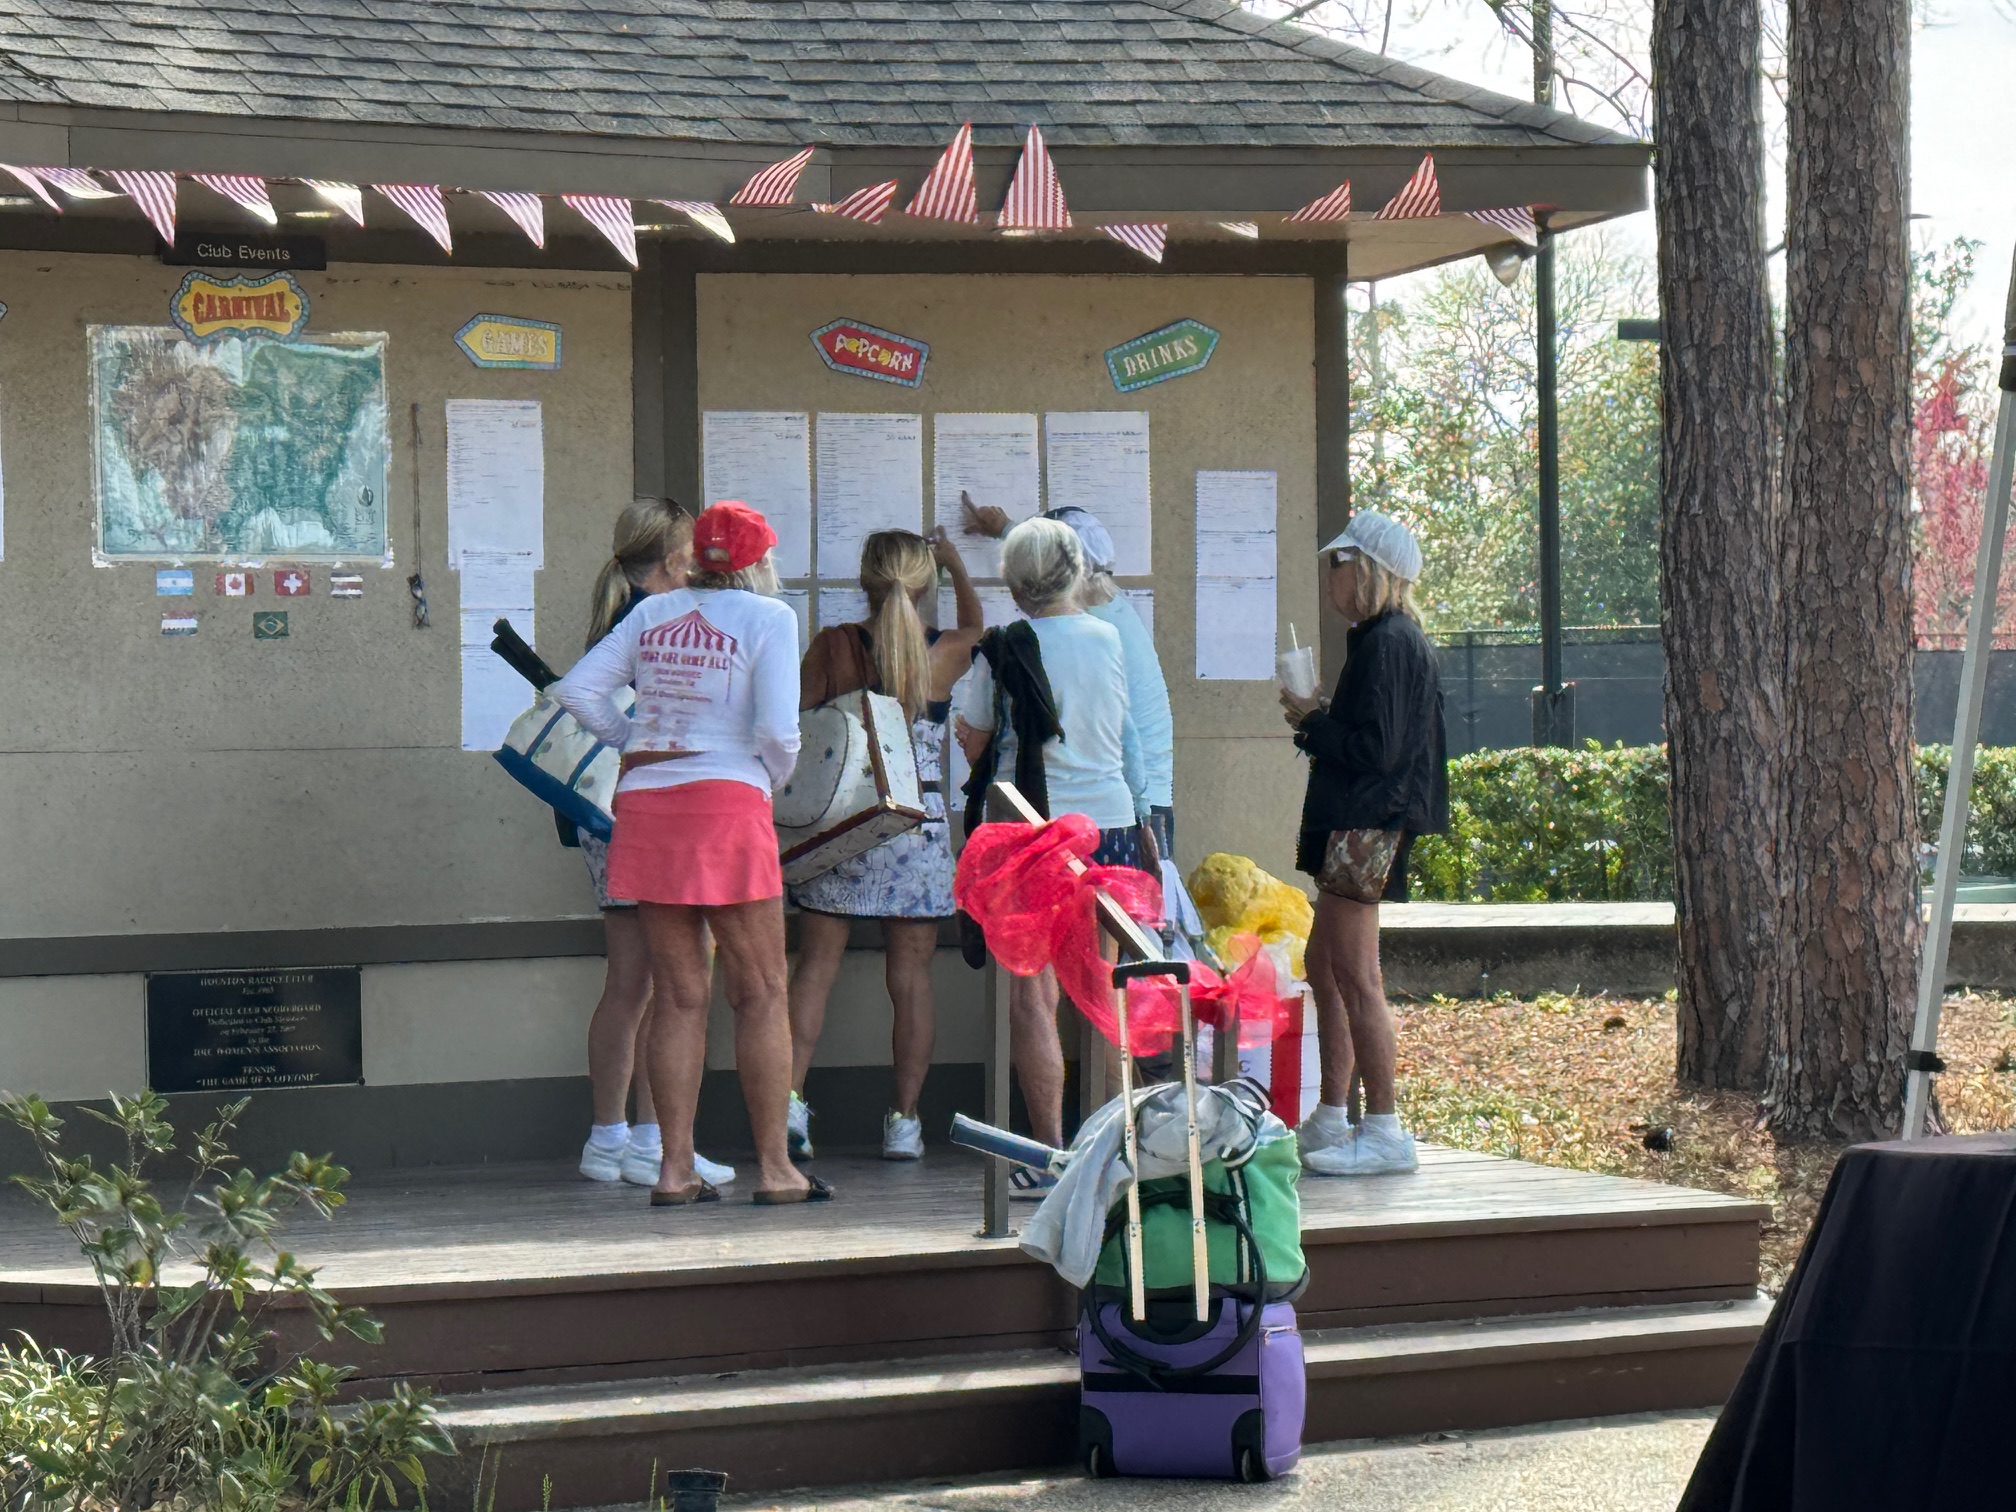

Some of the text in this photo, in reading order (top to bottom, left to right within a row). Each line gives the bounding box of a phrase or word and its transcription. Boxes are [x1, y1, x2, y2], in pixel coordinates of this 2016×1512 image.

[197, 243, 291, 261] Club Events
[192, 290, 292, 325] CARNIVAL
[481, 328, 548, 357] GAMES
[834, 333, 914, 372] POPCORN
[1122, 334, 1199, 377] DRINKS
